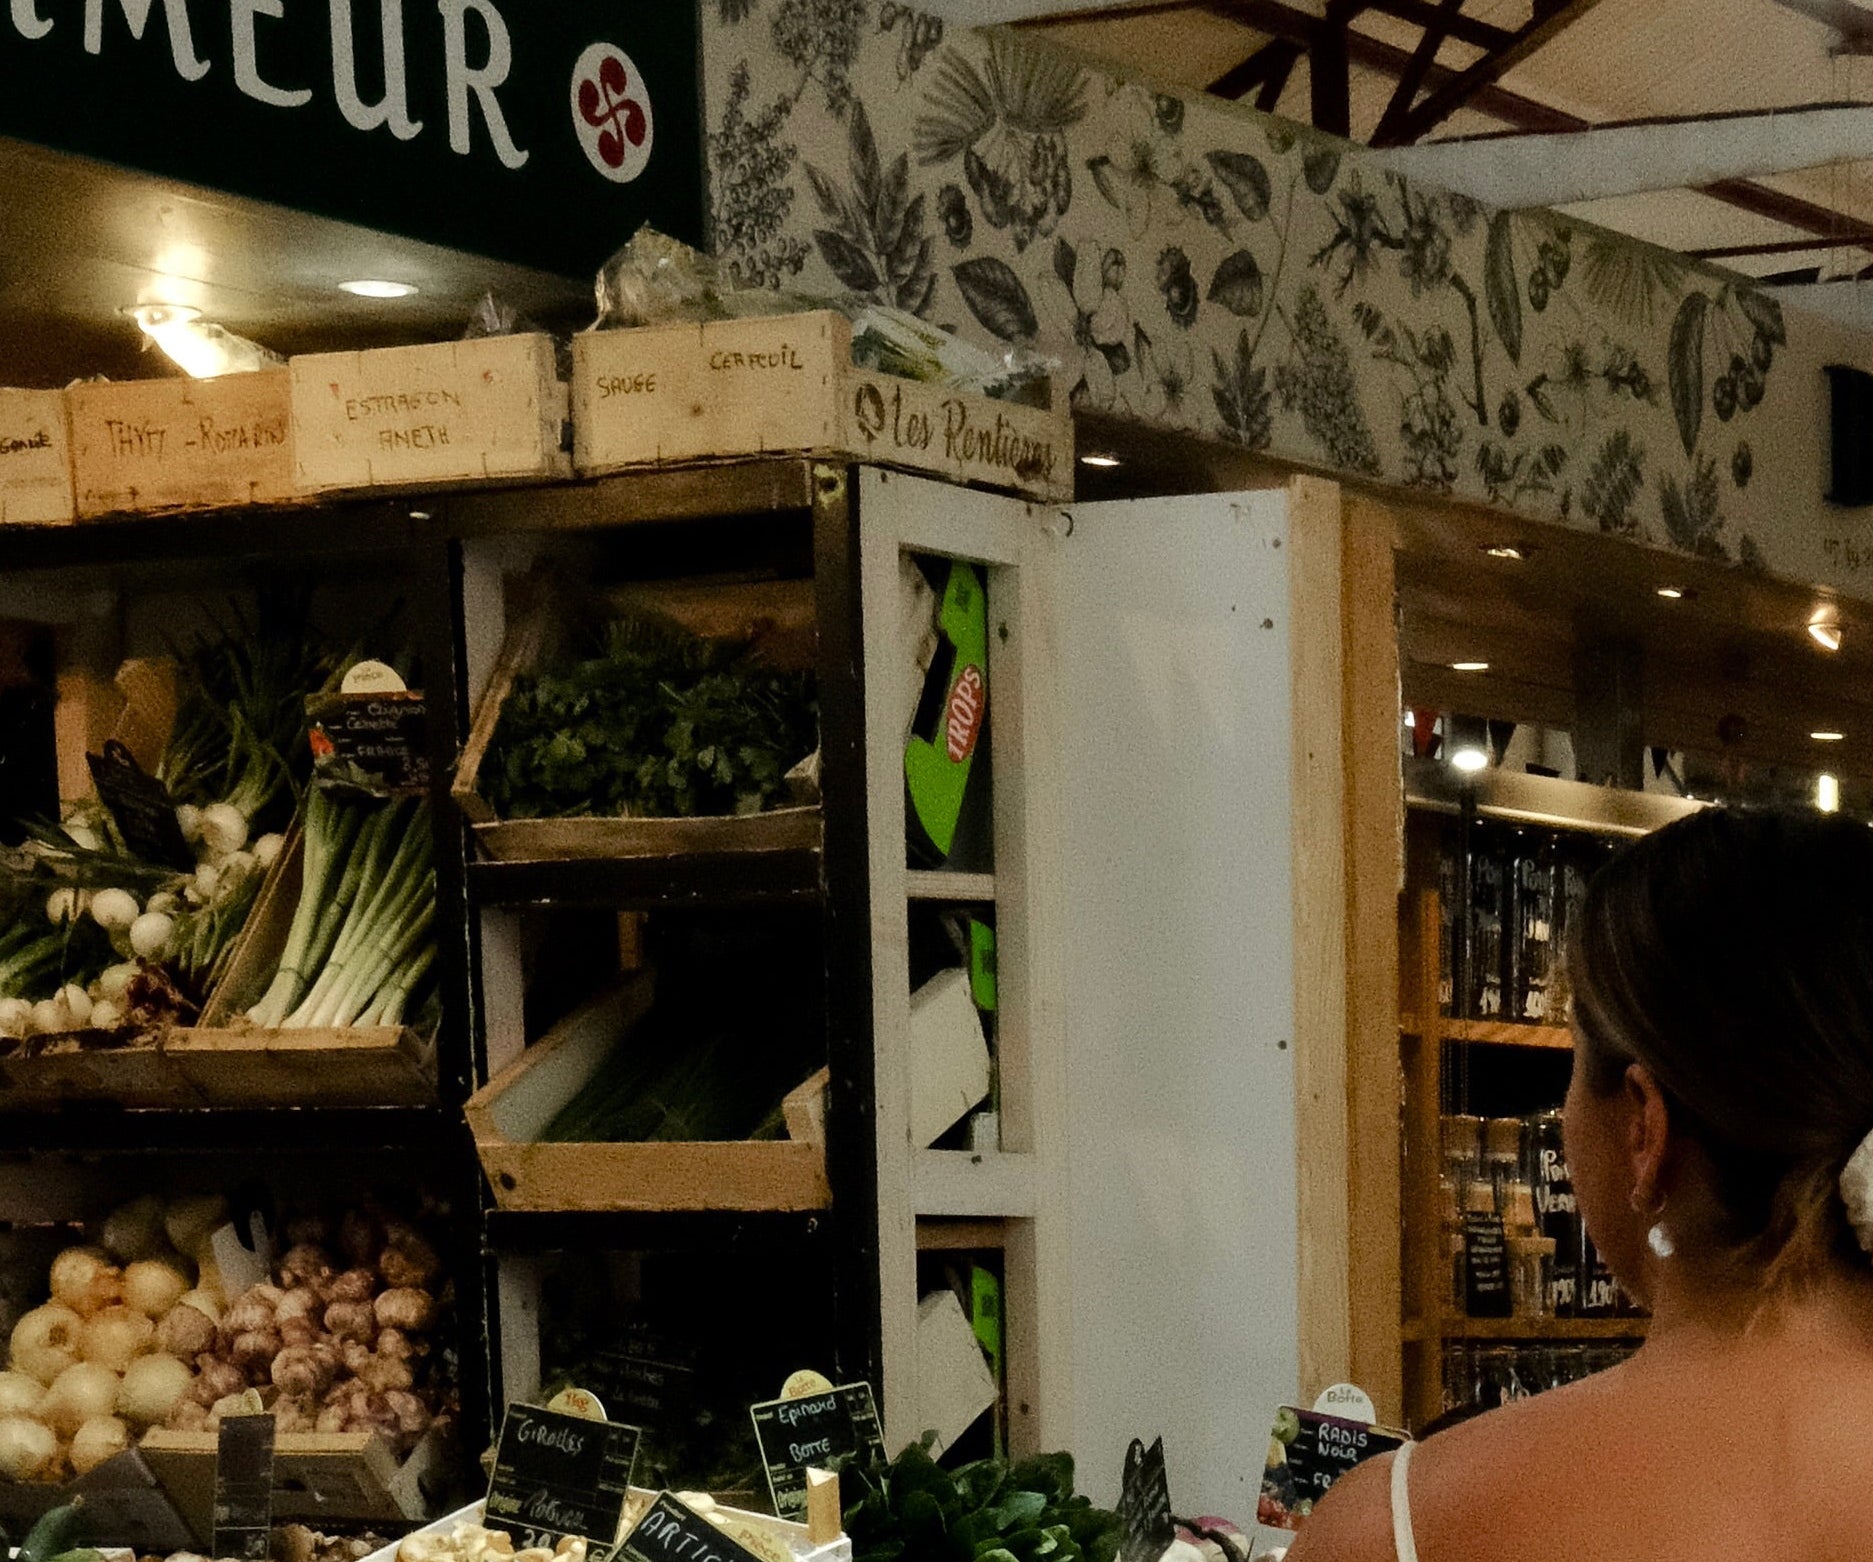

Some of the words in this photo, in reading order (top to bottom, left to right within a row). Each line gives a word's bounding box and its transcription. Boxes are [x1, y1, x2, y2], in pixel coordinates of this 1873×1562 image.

[9, 0, 529, 169] MEUR
[378, 426, 451, 451] ANETH
[1326, 1391, 1364, 1404] Botte
[777, 1396, 838, 1428] Epinard
[1318, 1422, 1368, 1448] RADIS
